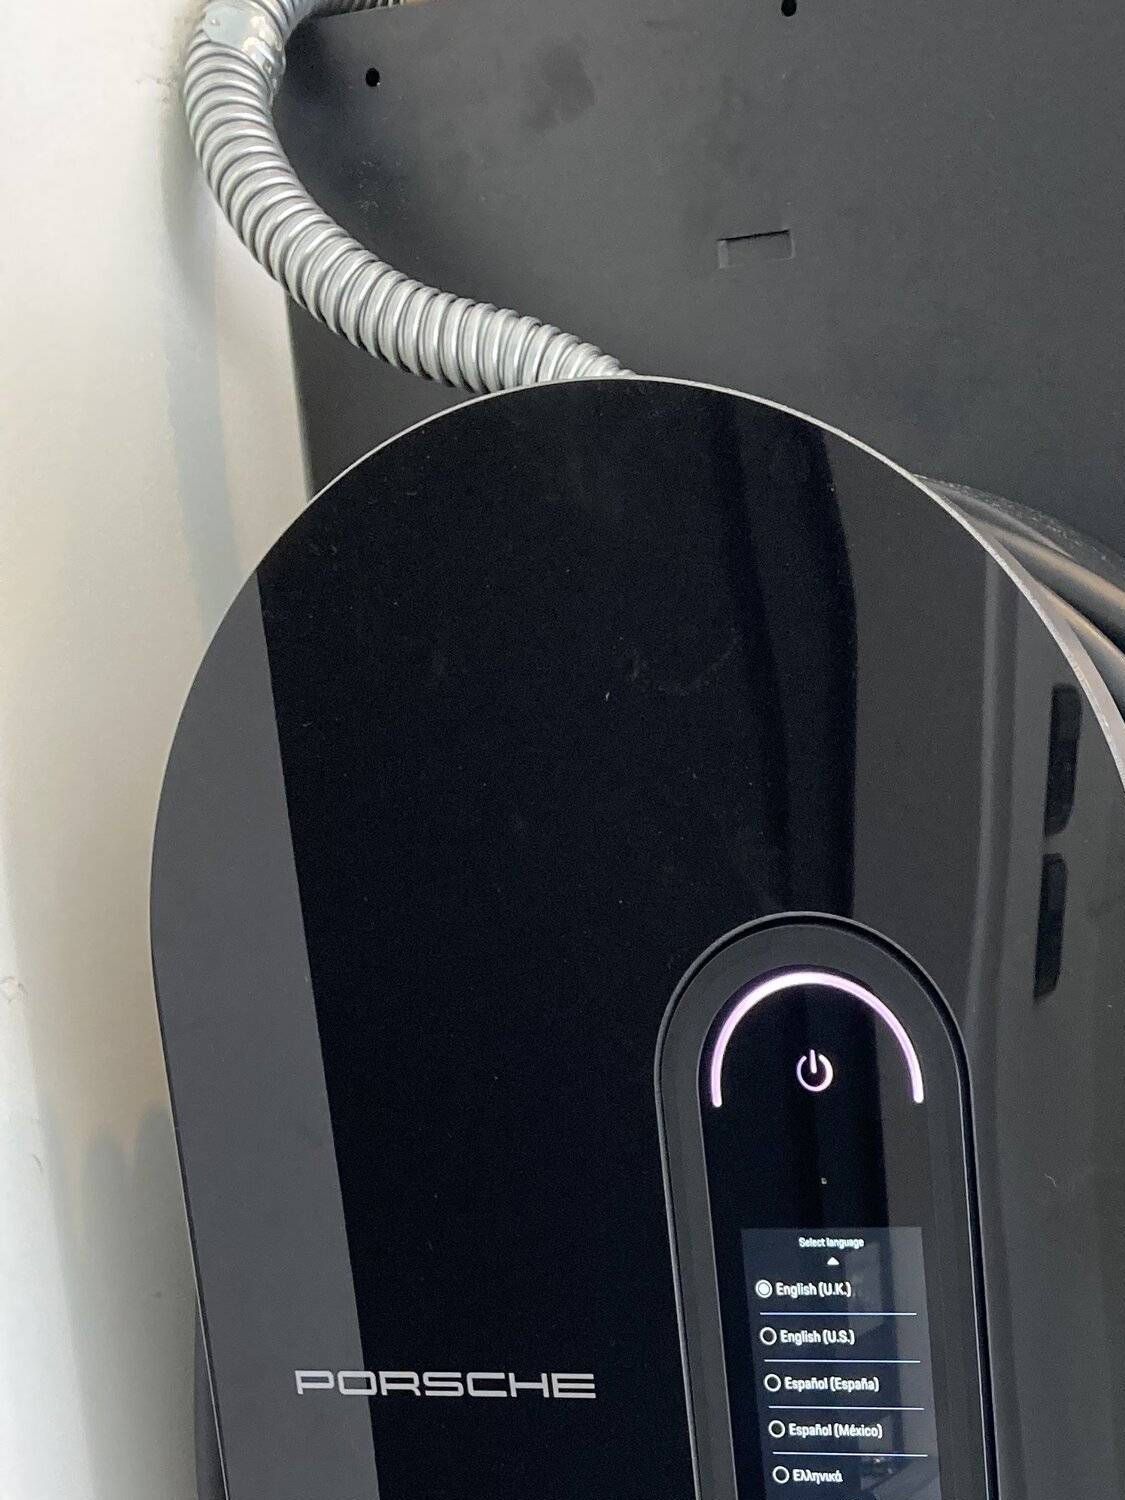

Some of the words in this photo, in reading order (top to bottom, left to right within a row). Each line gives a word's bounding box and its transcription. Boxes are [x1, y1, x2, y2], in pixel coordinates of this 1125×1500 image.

[798, 1236, 825, 1248] Select
[826, 1237, 864, 1250] language
[775, 1281, 817, 1298] English
[818, 1281, 852, 1298] (U.K.)
[779, 1329, 821, 1345] English
[822, 1328, 855, 1345] (U.S.)
[294, 1369, 597, 1399] PORSCHE
[784, 1376, 828, 1393] Español
[830, 1376, 879, 1393] (España)
[788, 1422, 832, 1439] Español
[834, 1422, 882, 1439] (México)
[792, 1468, 843, 1485] Ελληνικά
